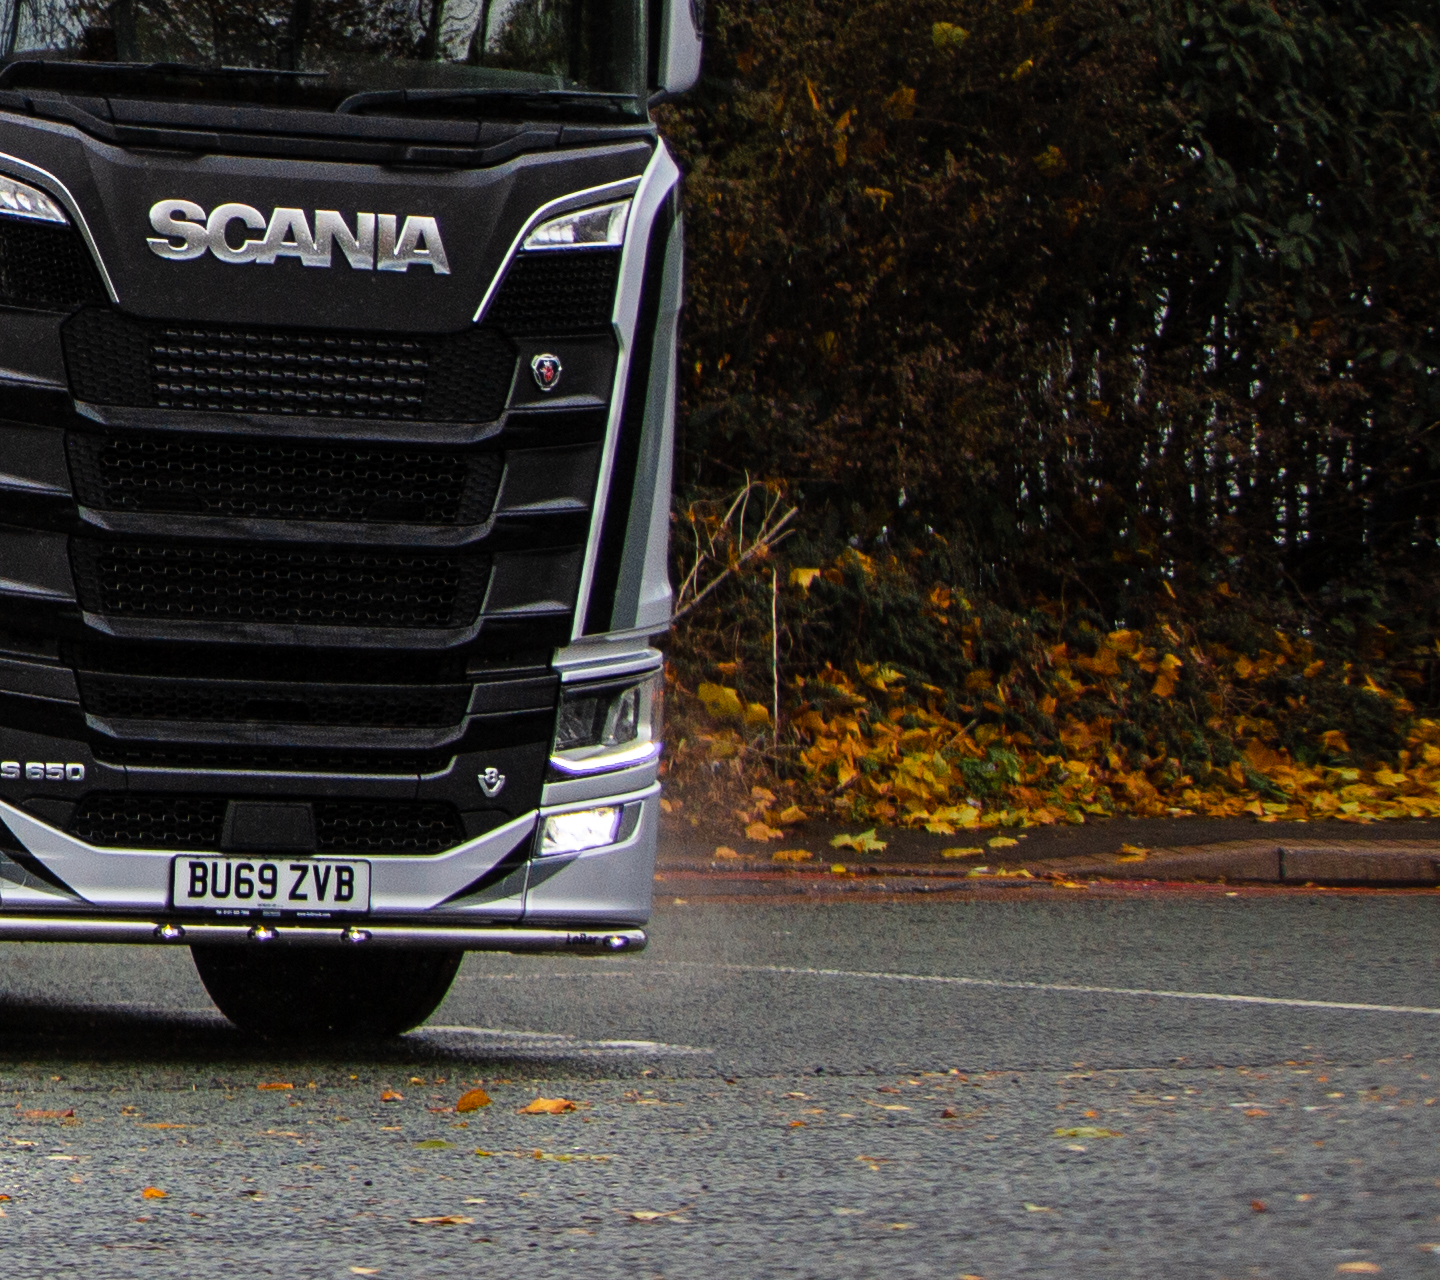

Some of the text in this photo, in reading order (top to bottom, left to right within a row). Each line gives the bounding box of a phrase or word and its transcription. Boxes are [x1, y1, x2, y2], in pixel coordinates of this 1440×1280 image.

[146, 199, 451, 275] SCANIA
[0, 761, 85, 781] S 650
[188, 861, 355, 902] BU69 ZVB
